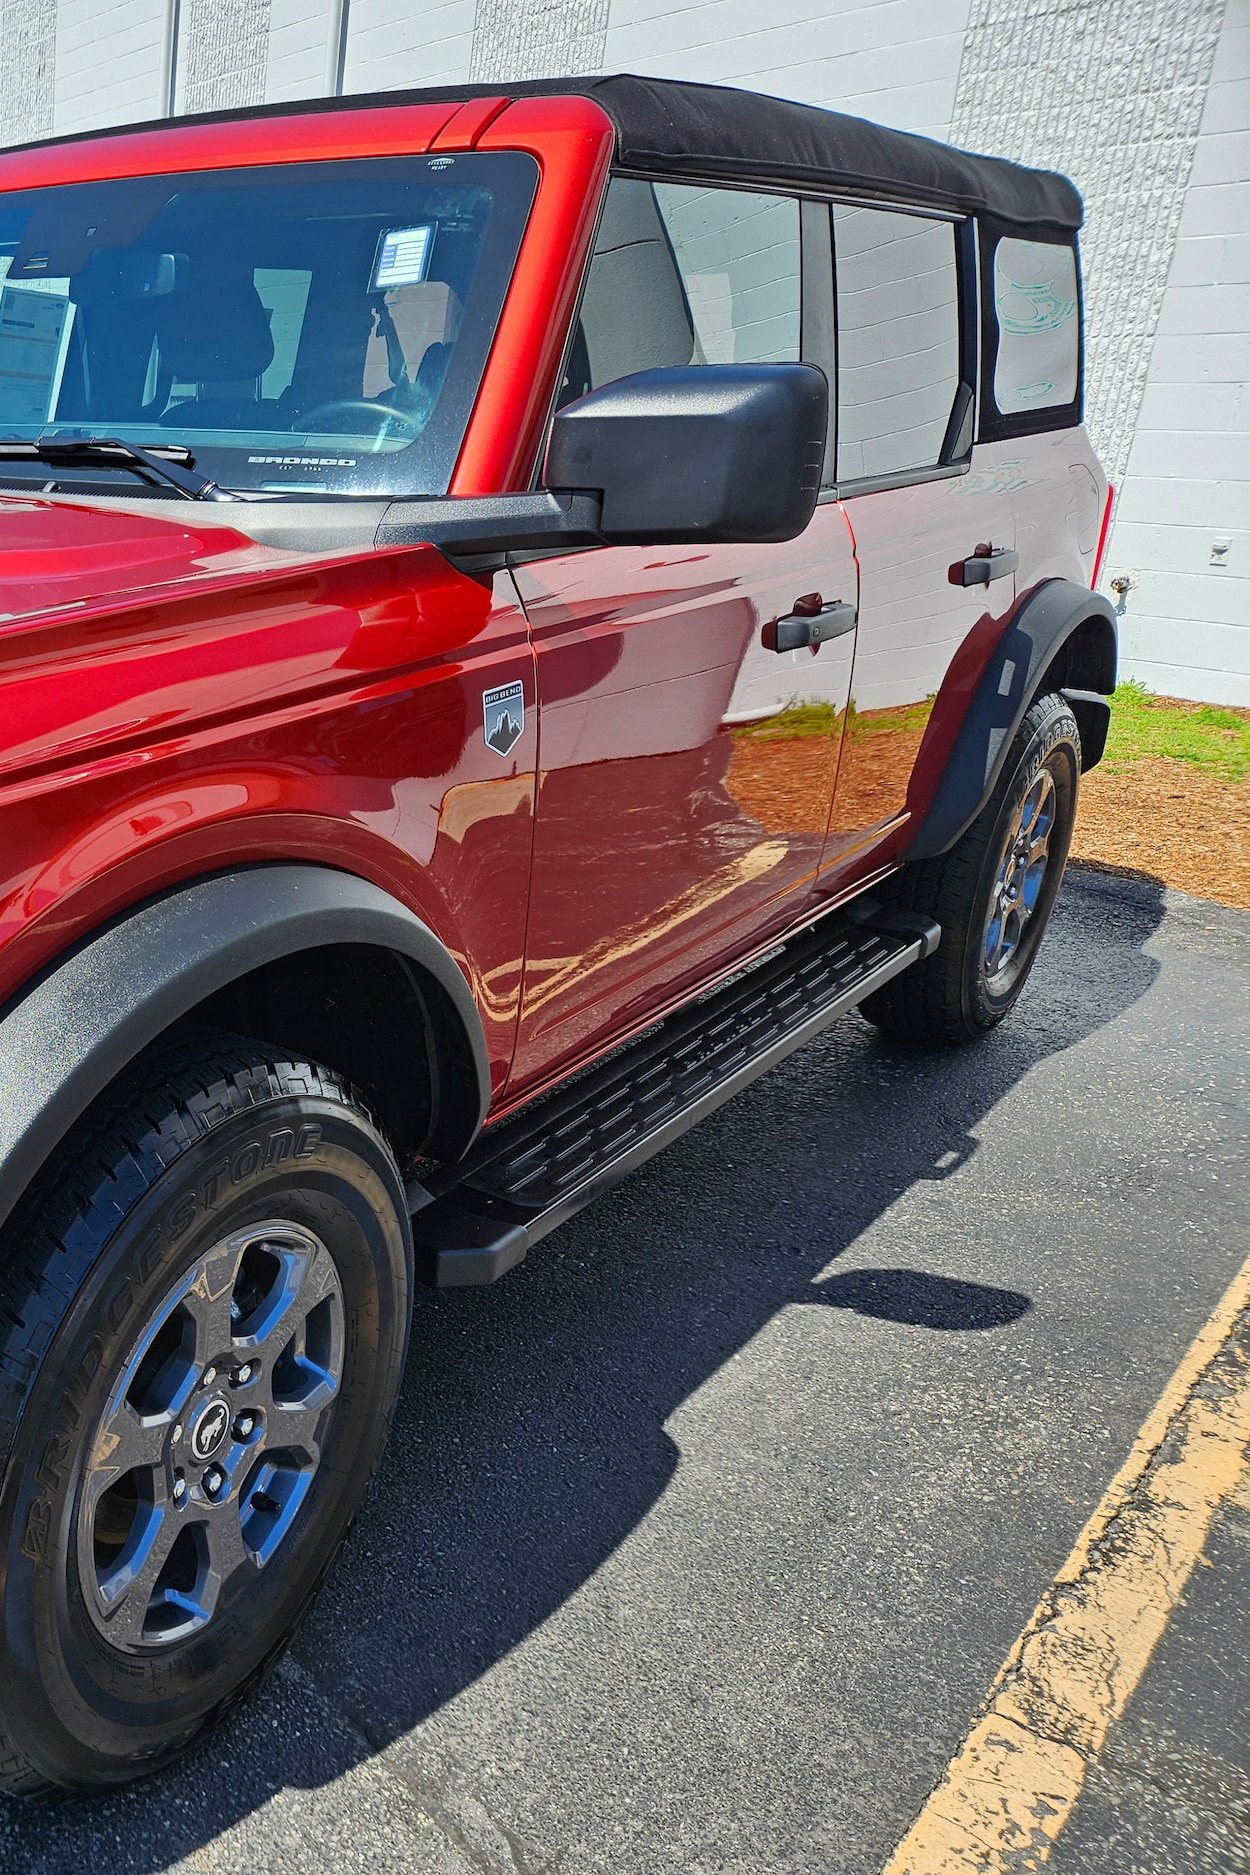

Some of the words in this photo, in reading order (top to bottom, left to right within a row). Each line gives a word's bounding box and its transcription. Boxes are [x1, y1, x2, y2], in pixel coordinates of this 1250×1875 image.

[248, 456, 357, 467] BRONCO
[485, 693, 500, 704] BIG
[500, 685, 521, 699] BEND
[24, 1122, 324, 1563] BRIDGESTONE
